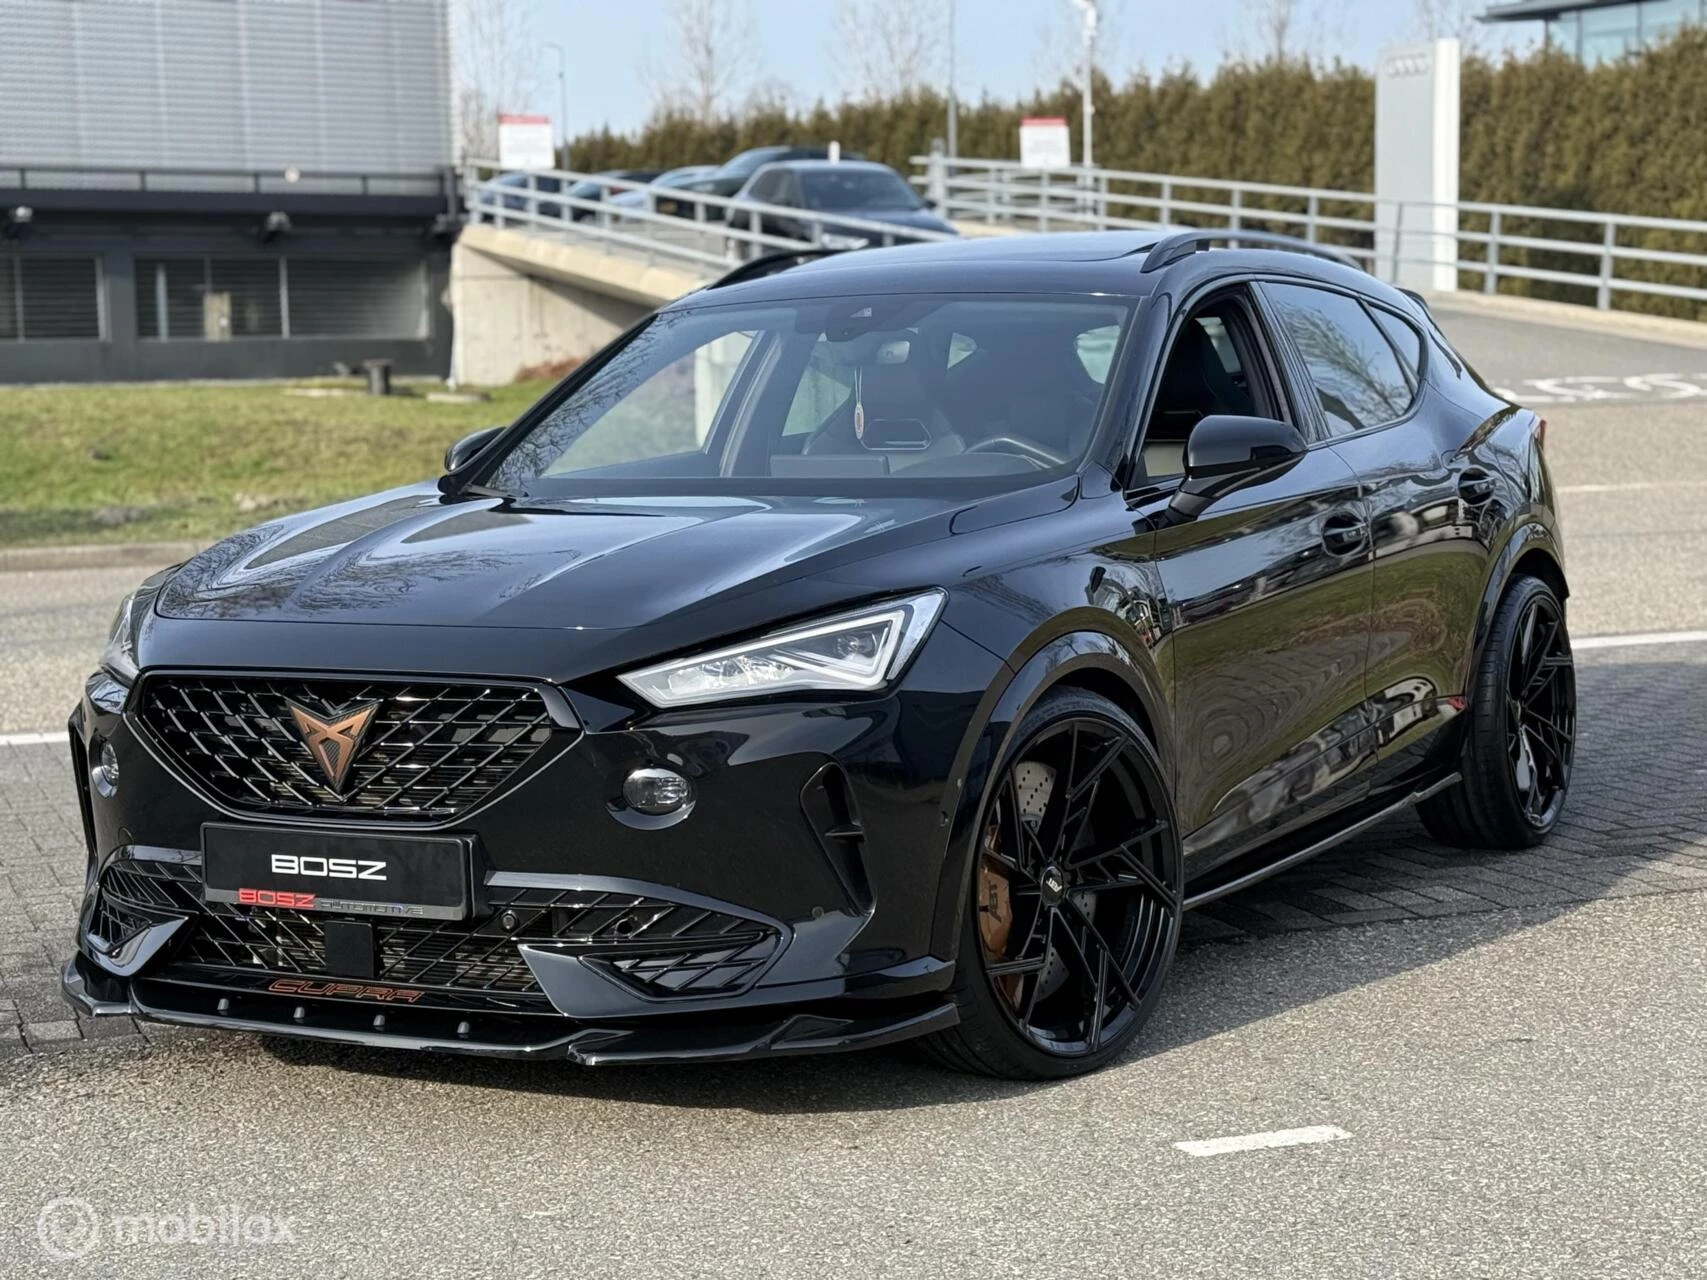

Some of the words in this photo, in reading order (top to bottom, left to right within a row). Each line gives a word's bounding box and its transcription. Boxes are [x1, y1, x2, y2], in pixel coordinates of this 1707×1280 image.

[271, 854, 387, 881] BOSZ
[238, 887, 317, 909] BOSZ
[268, 978, 425, 1003] CUPRA
